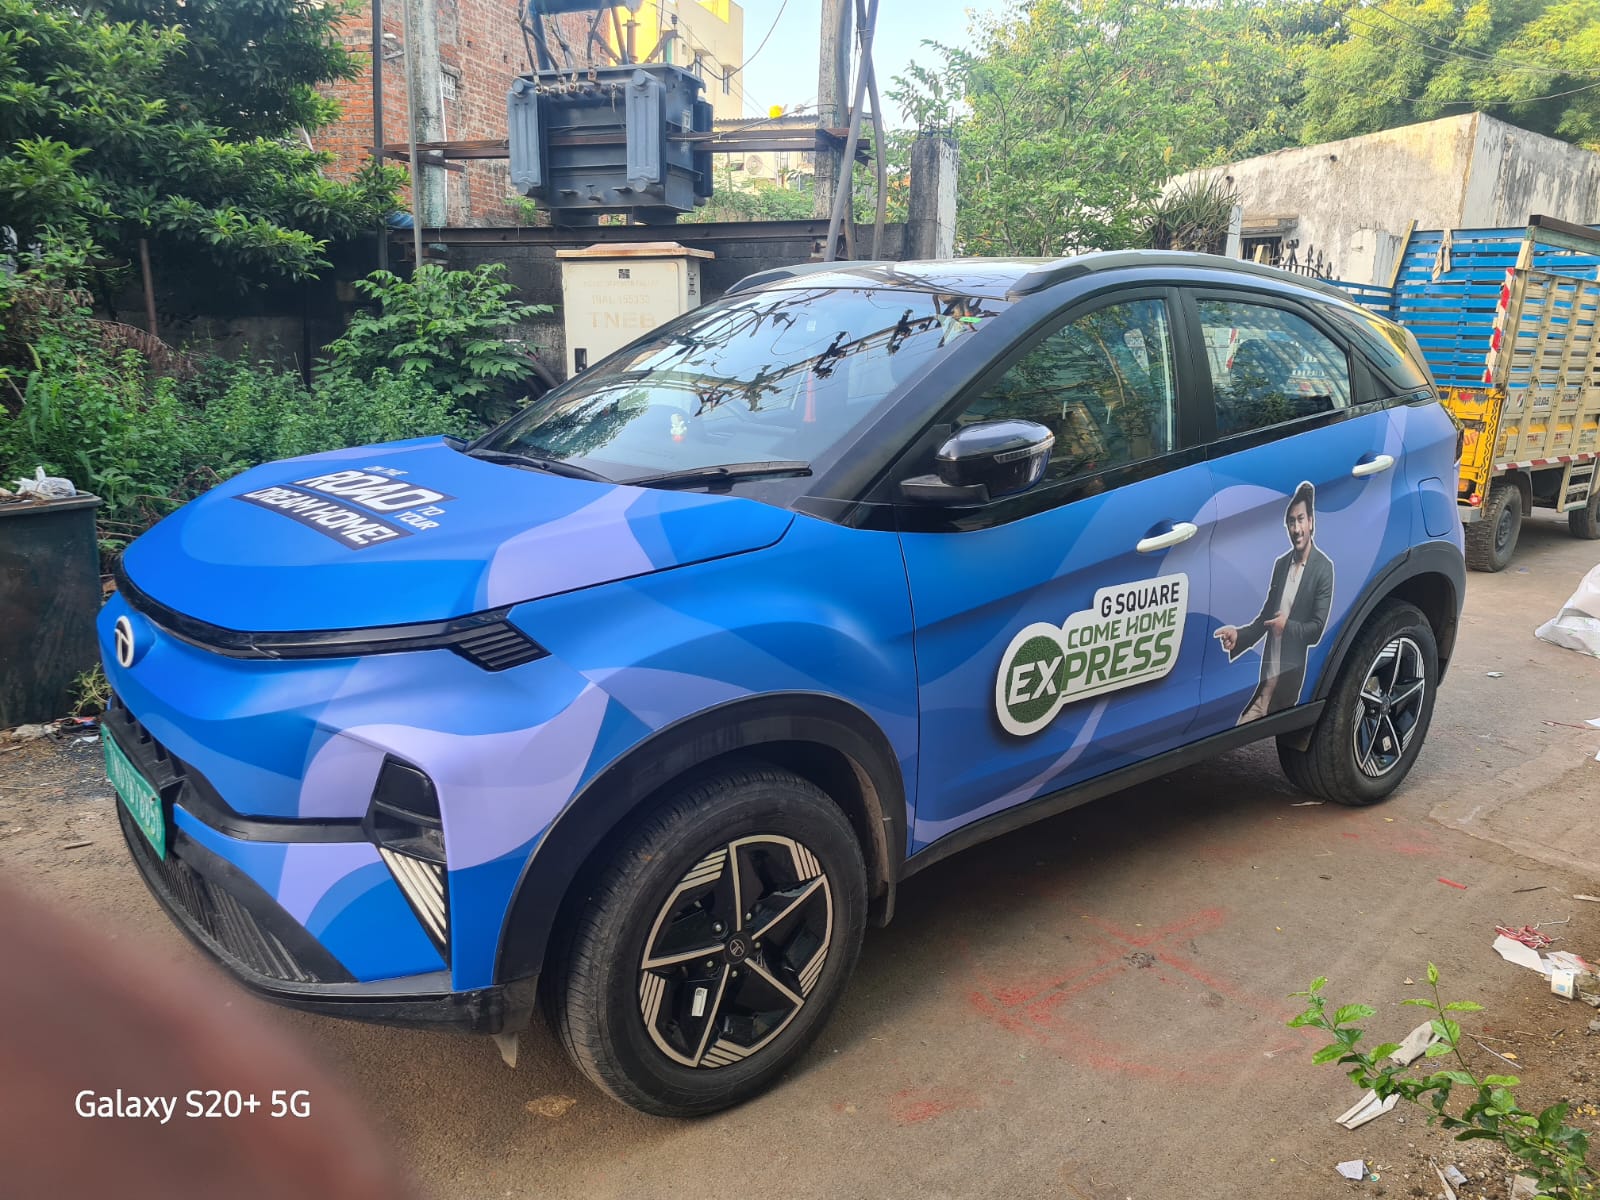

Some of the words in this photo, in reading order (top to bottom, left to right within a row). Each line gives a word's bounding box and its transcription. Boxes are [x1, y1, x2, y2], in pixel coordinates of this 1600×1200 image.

[590, 311, 657, 329] TNEB
[293, 469, 445, 511] ROAD
[243, 486, 330, 513] DREAM
[301, 505, 400, 545] HOME!
[394, 510, 440, 530] YOUR
[417, 505, 446, 517] TO
[1101, 596, 1112, 618] G
[1115, 581, 1180, 614] SQUARE
[1067, 619, 1122, 650] COME
[1126, 606, 1178, 636] HOME
